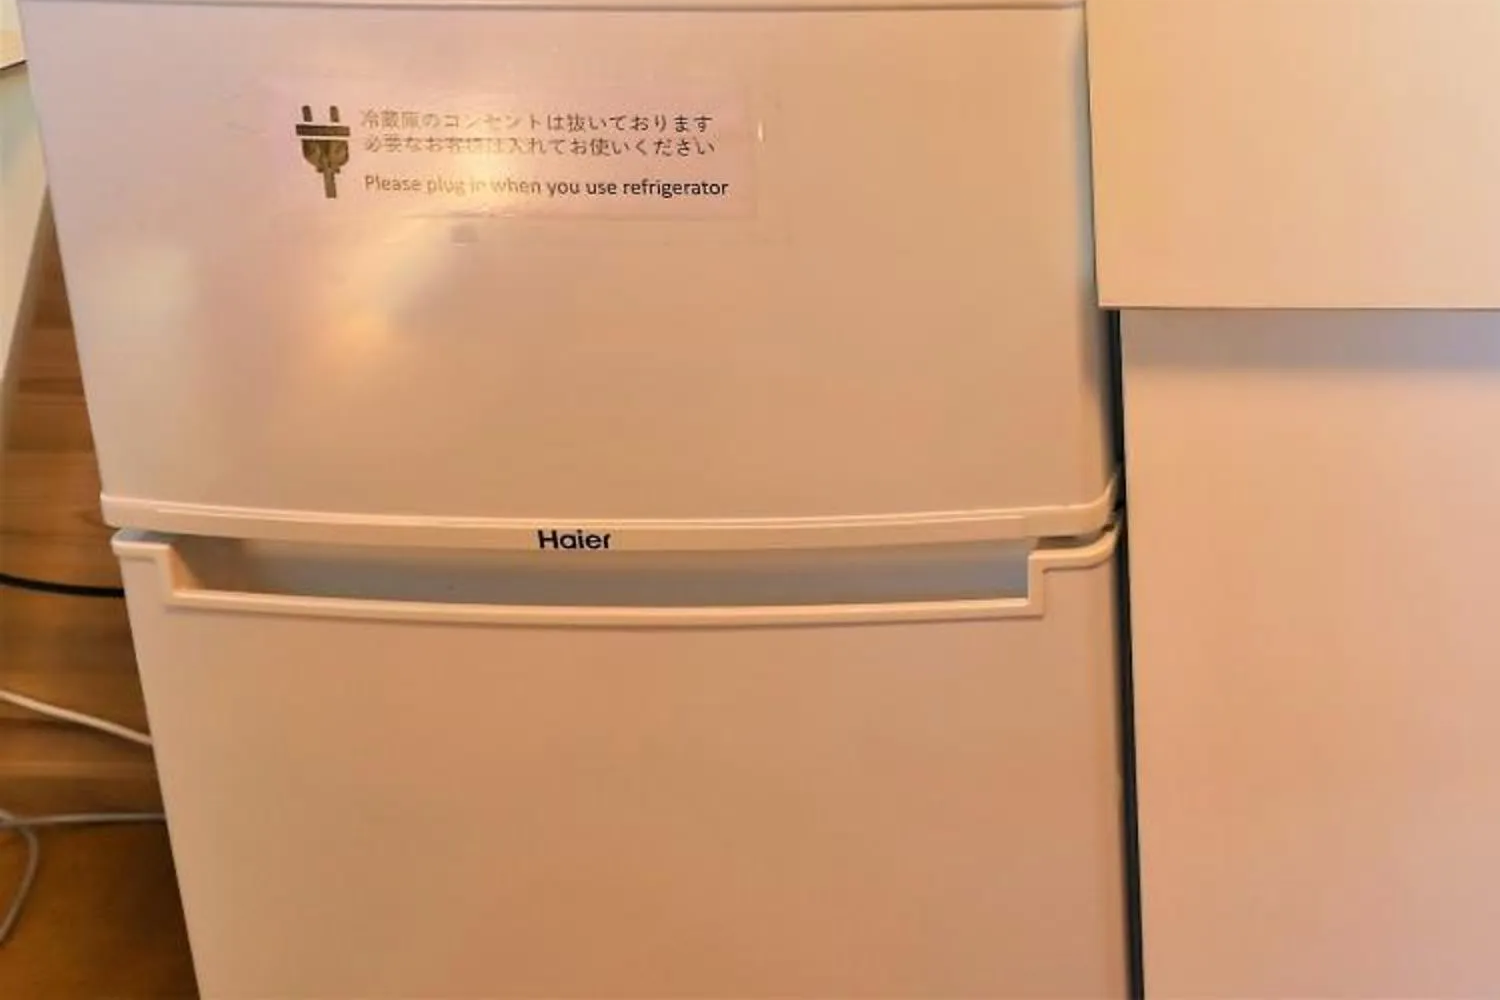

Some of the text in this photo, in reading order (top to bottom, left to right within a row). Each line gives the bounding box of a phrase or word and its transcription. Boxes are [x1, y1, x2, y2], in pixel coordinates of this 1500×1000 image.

[365, 174, 421, 191] Please
[427, 175, 466, 196] plug
[490, 178, 541, 195] when
[547, 181, 580, 198] you
[586, 182, 617, 195] use
[623, 178, 729, 198] refrigerator
[537, 529, 611, 549] Haier
